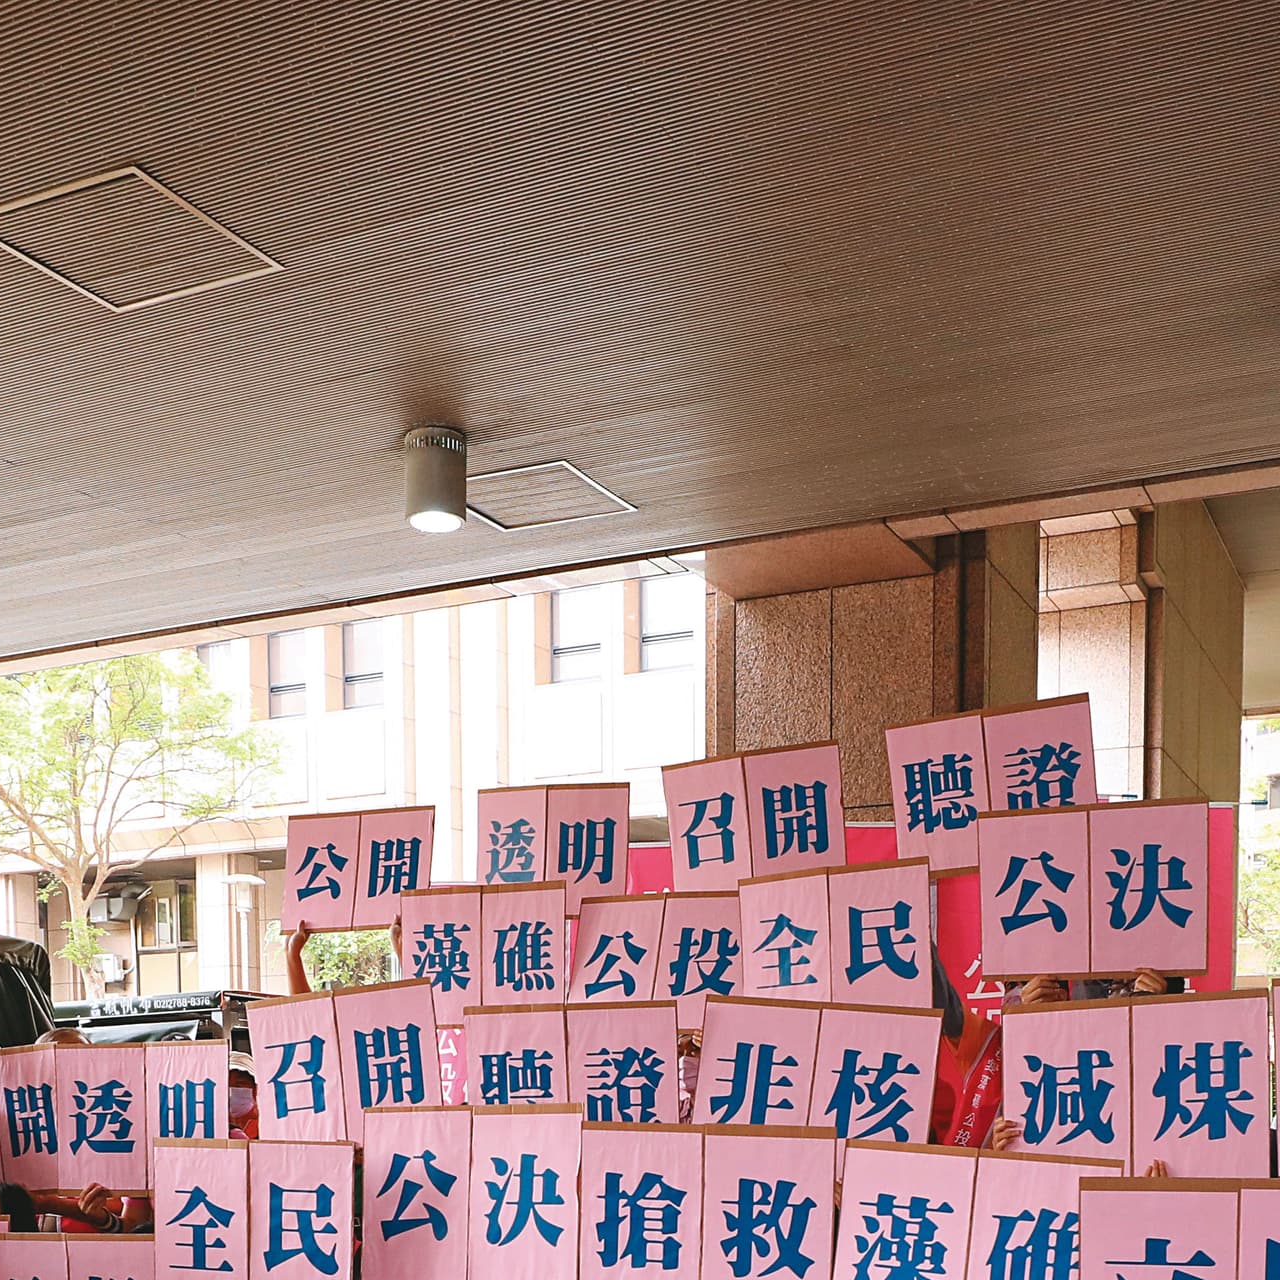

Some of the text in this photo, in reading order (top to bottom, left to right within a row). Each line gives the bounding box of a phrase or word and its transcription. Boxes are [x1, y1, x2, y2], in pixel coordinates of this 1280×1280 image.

[679, 780, 828, 871] 召開
[901, 742, 1081, 834] 聽證
[295, 837, 422, 901] 公開
[485, 817, 617, 885] 透明
[996, 843, 1193, 936] 公決
[412, 921, 555, 993] 藻礁
[584, 927, 740, 997] 公投
[752, 900, 920, 989] 全民
[268, 1022, 425, 1119] 召開
[480, 1046, 665, 1124] 聽證
[713, 1041, 920, 1144] 非核
[1022, 1040, 1255, 1146] 減煤
[167, 1182, 338, 1277] 全民
[378, 1149, 565, 1247] 公決
[596, 1171, 817, 1279] 搶救
